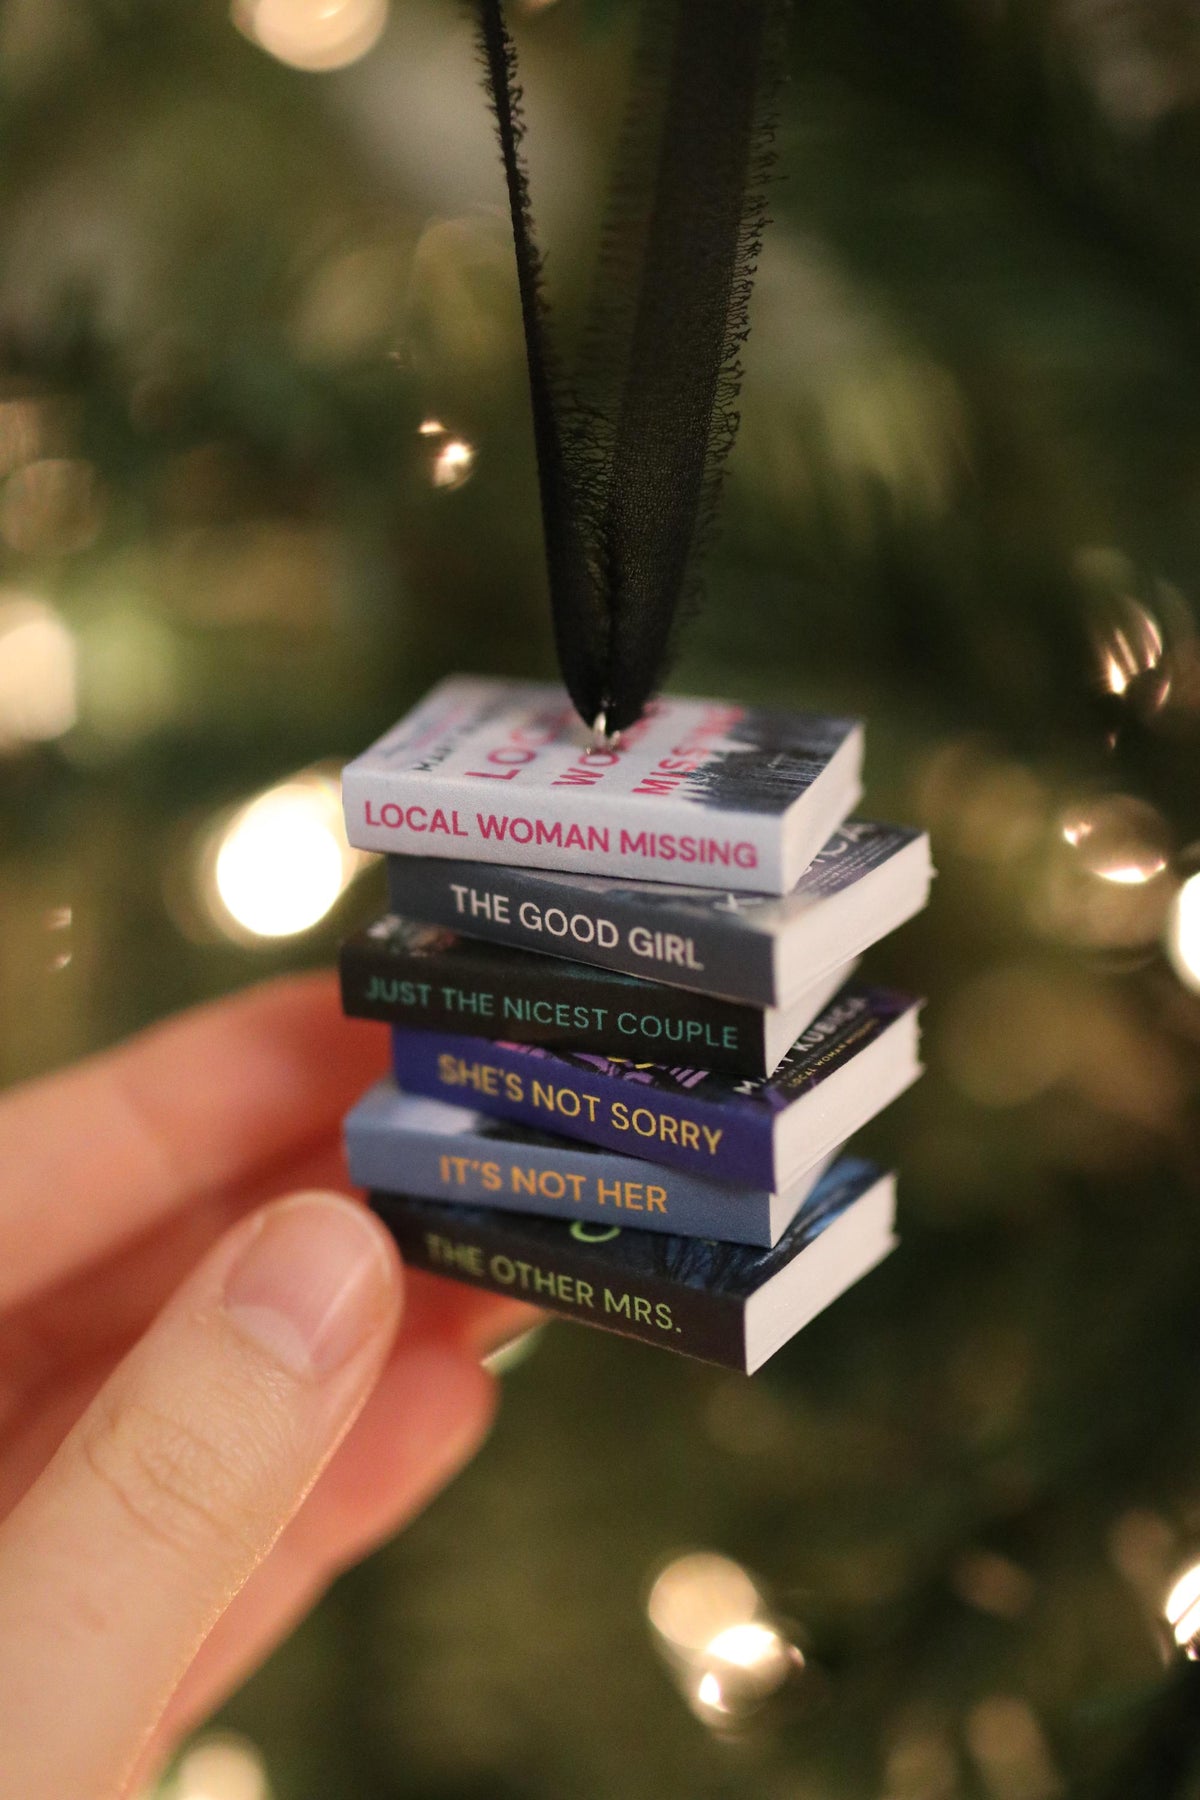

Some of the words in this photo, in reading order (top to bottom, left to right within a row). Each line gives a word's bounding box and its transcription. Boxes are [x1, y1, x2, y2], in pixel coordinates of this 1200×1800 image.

[364, 800, 469, 837] LOCAL
[476, 812, 610, 854] WOMAN
[619, 829, 759, 870] MISSING
[450, 883, 511, 925] THE
[518, 901, 620, 949] GOOD
[628, 926, 705, 972] GIRL
[366, 976, 432, 1008] JUST
[441, 987, 495, 1017] THE
[502, 995, 609, 1032] NICEST
[617, 1011, 739, 1050] COUPLE
[437, 1053, 524, 1102] SHE'S
[532, 1080, 601, 1122] NOT
[611, 1102, 723, 1155] SORRY
[439, 1155, 503, 1191] IT'S
[511, 1166, 587, 1202] NOT
[597, 1178, 668, 1214] HER
[426, 1232, 485, 1277] THE
[490, 1255, 594, 1308] OTHER
[604, 1288, 682, 1333] MRS.
